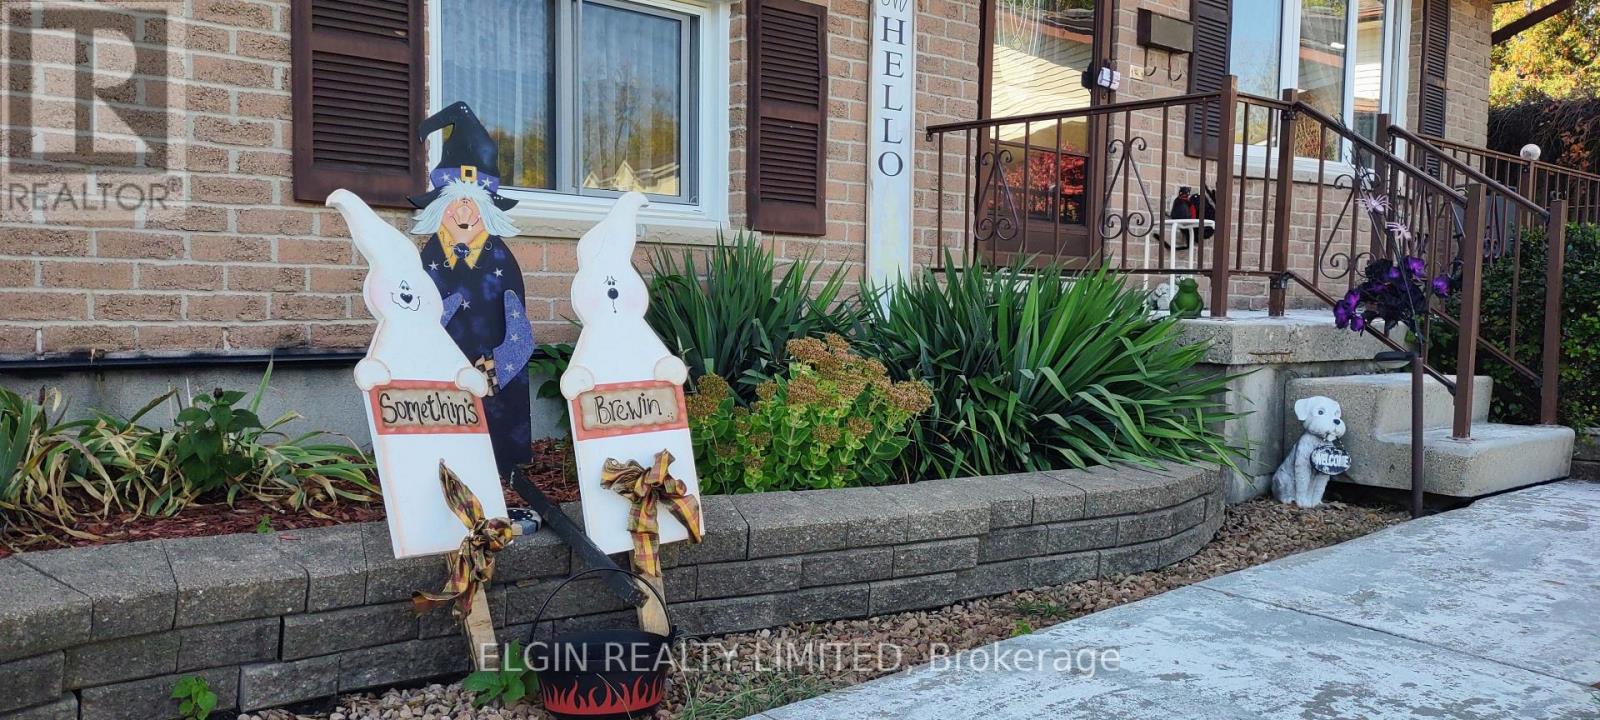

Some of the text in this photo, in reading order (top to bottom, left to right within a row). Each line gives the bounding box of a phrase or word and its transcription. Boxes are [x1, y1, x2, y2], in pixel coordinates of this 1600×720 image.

[878, 15, 905, 177] HELLO
[380, 391, 479, 425] Somethin's
[1314, 452, 1349, 468] WELCOME
